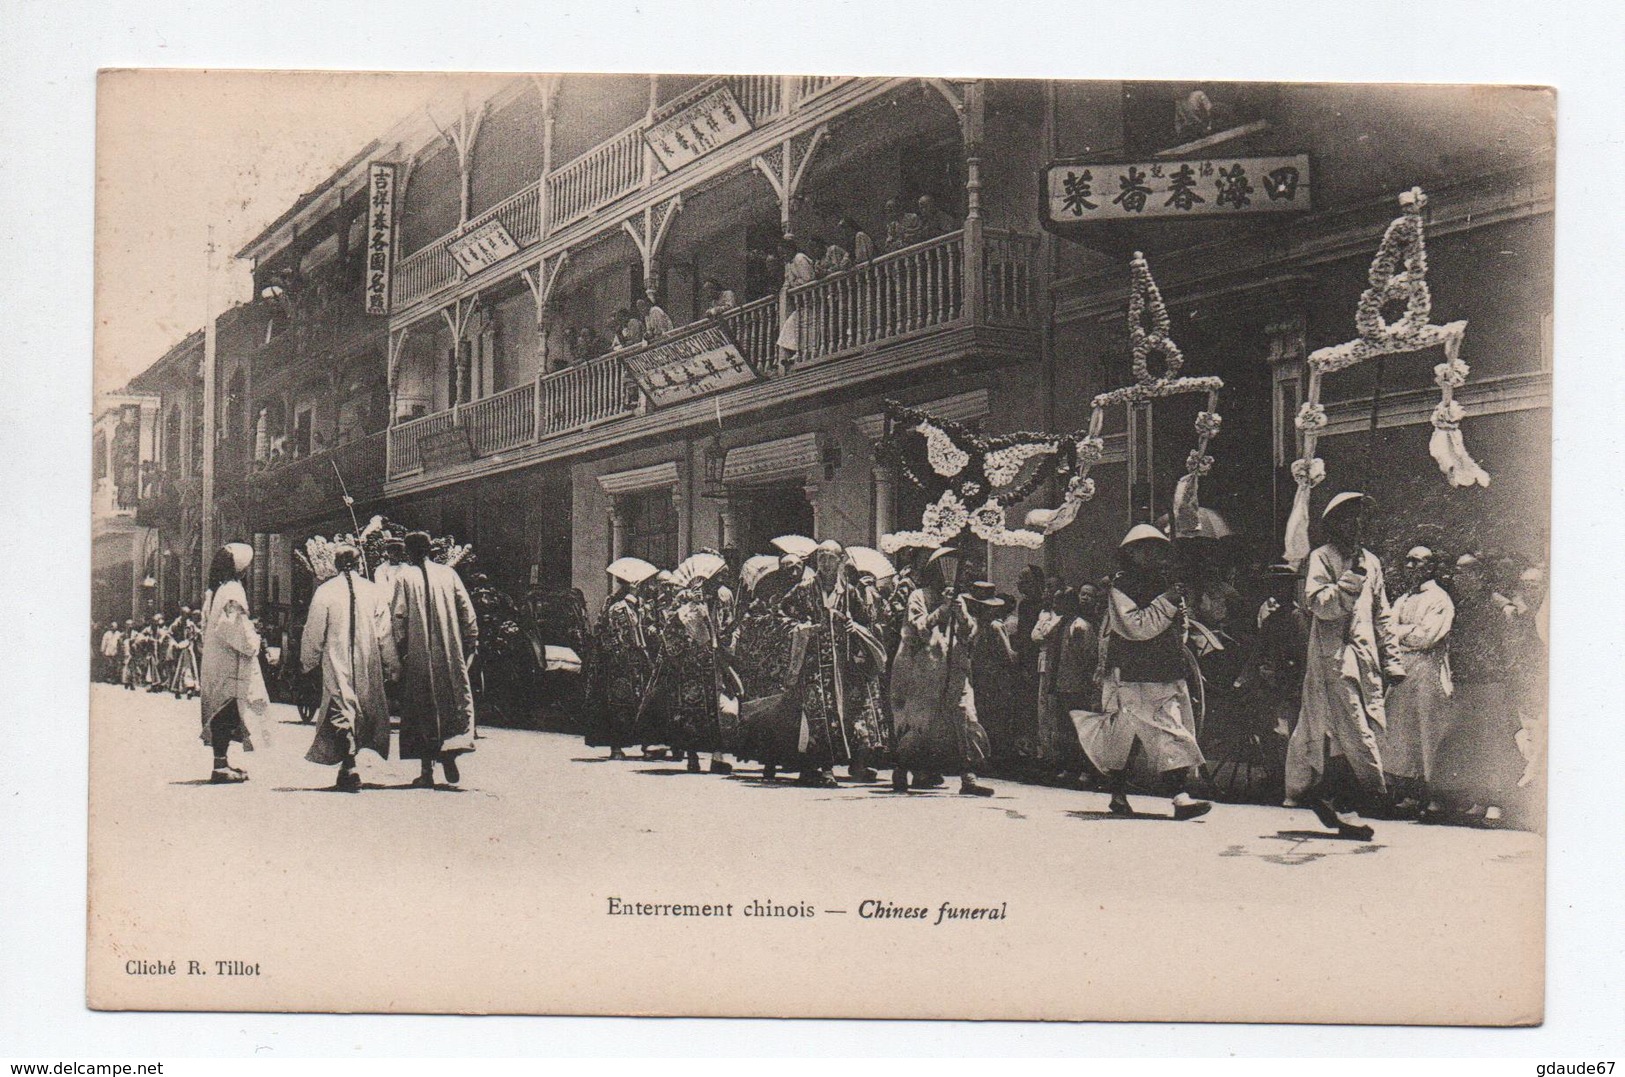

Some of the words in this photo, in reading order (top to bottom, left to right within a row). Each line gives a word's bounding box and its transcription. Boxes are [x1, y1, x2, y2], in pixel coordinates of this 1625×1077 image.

[608, 897, 733, 916] Enterrement
[744, 899, 814, 917] chinois
[859, 900, 928, 919] Chinese
[934, 902, 1006, 925] funeral
[126, 960, 175, 975] Cliché
[188, 961, 206, 975] R.
[216, 961, 260, 975] Tillot
